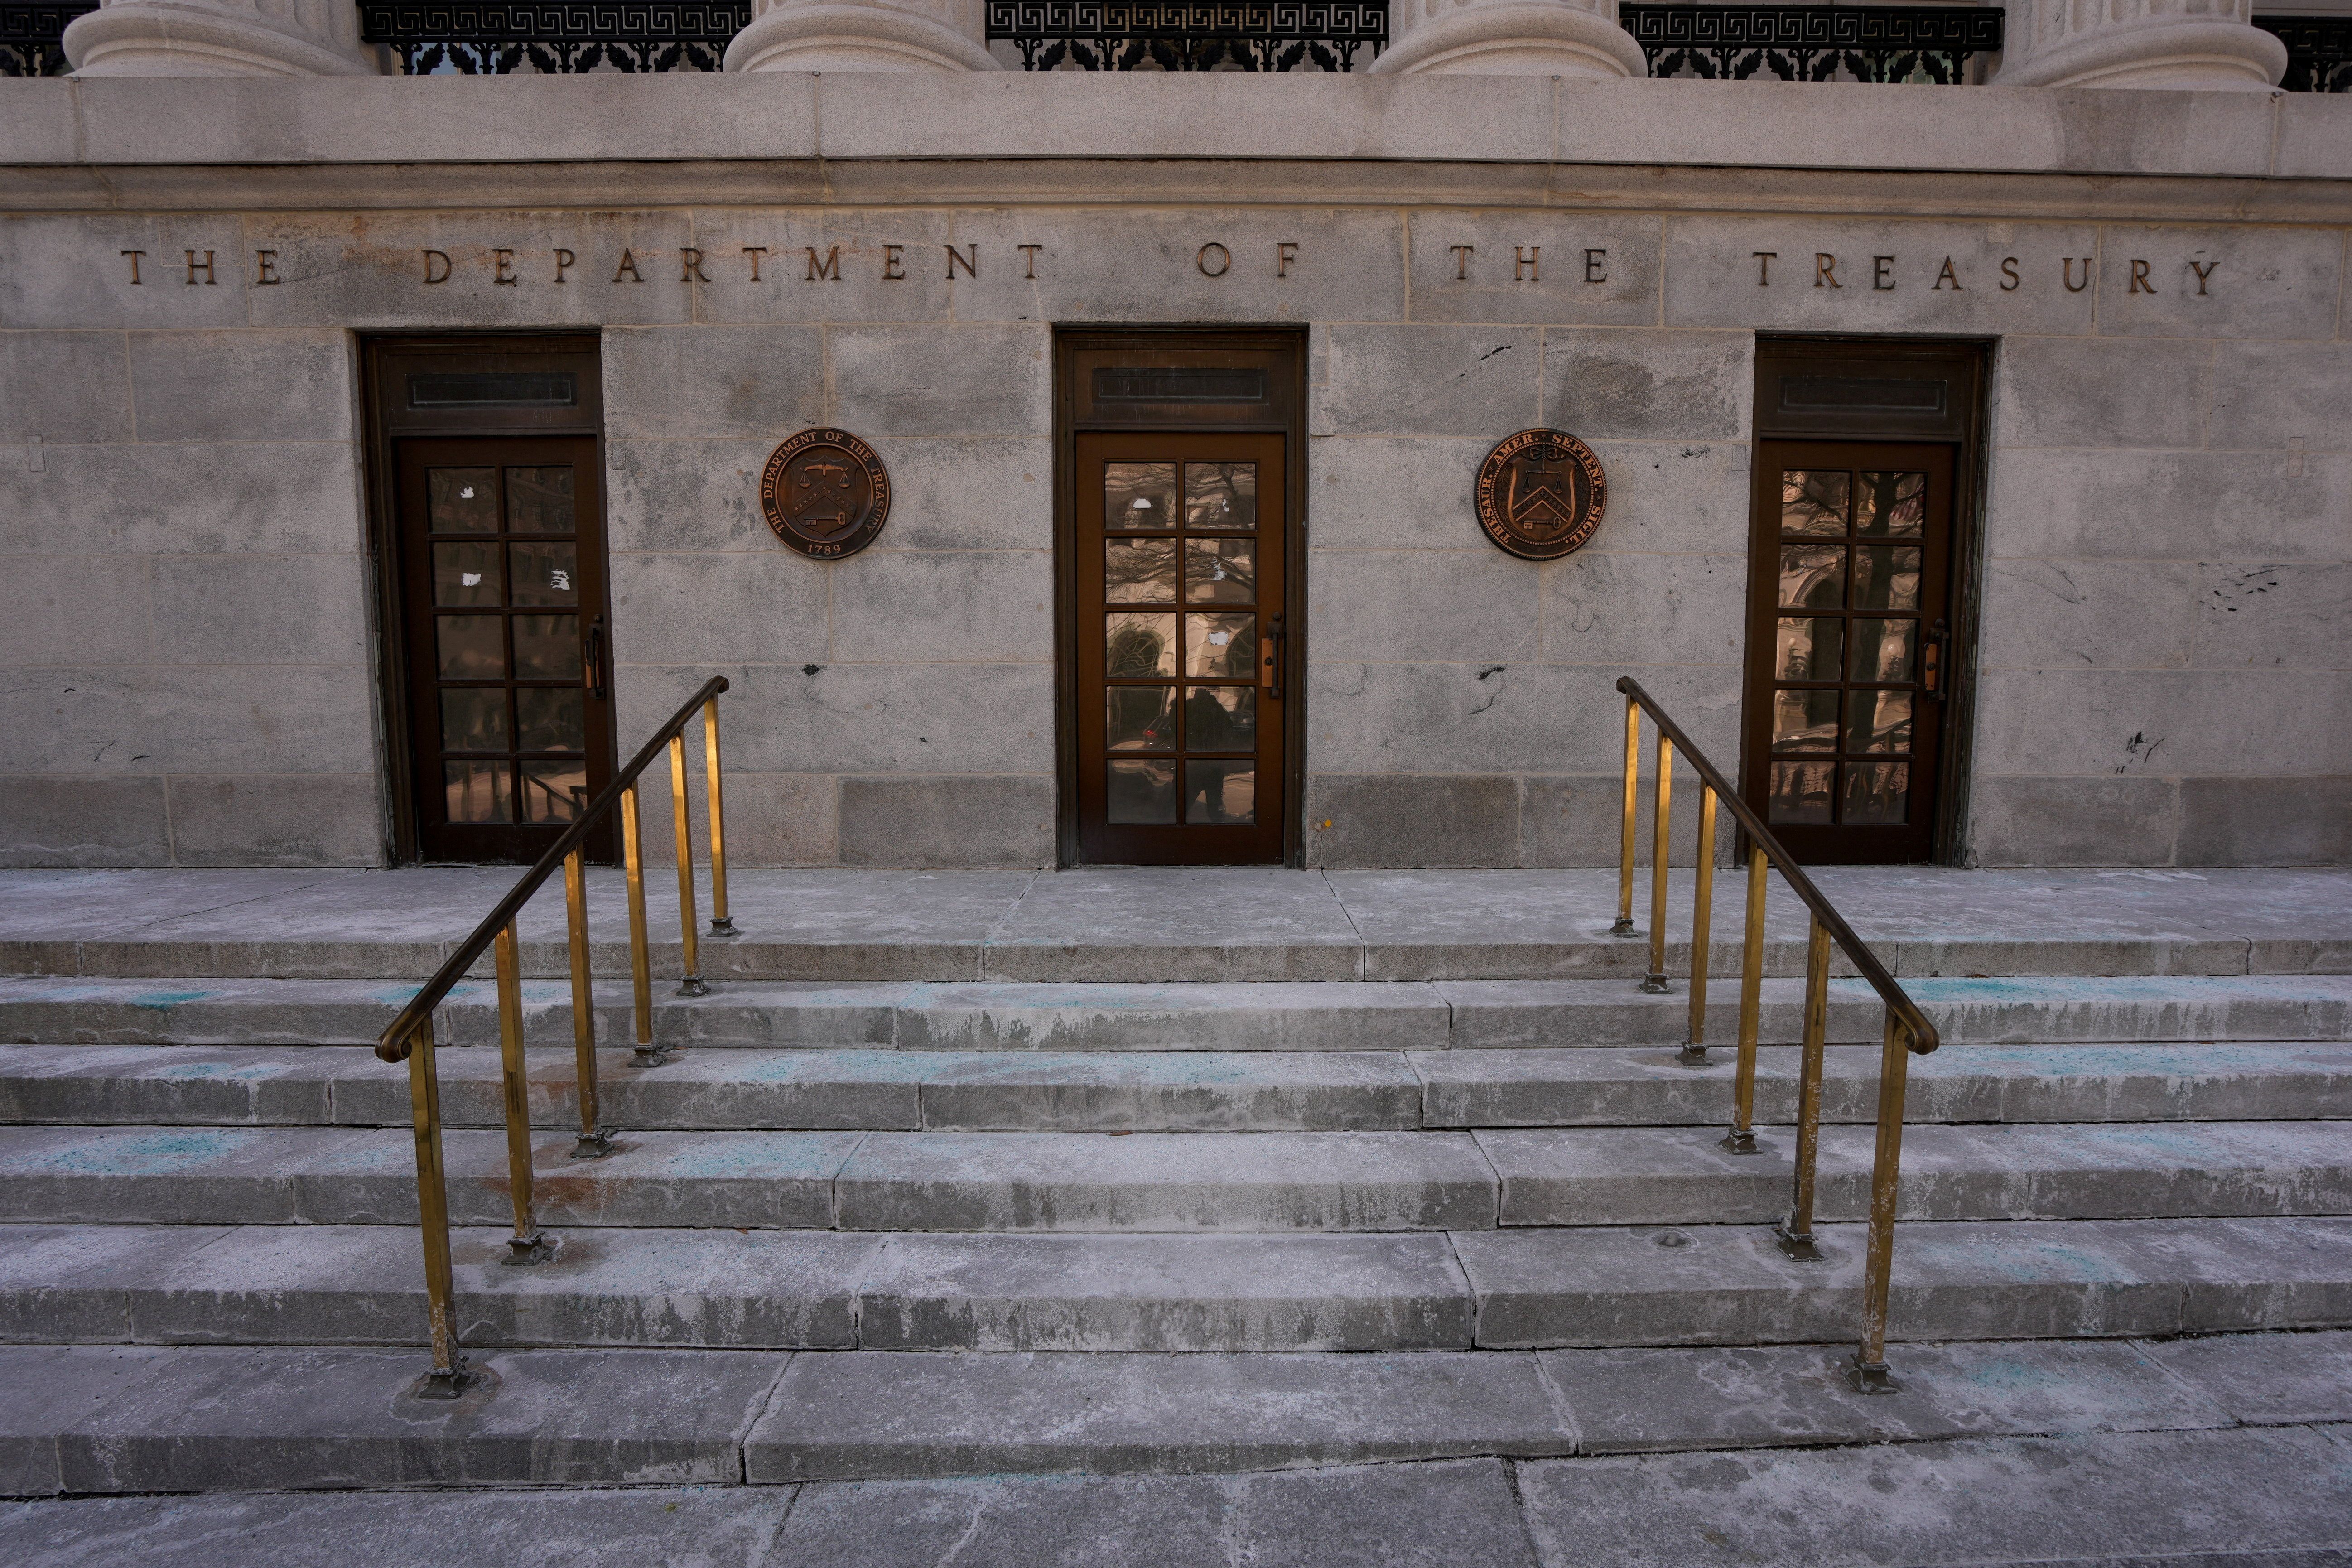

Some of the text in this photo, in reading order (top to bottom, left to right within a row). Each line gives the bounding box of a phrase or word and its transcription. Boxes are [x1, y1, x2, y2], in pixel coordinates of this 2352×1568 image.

[121, 242, 2221, 297] THE DEPARTMENT OF THE TREASURY
[764, 431, 885, 533] THE DEPARTMENT OF THE TREASURY
[1482, 434, 1603, 544] THESAUR. AMER. SEPTENT. SIGIL.
[807, 544, 840, 555] 1789
